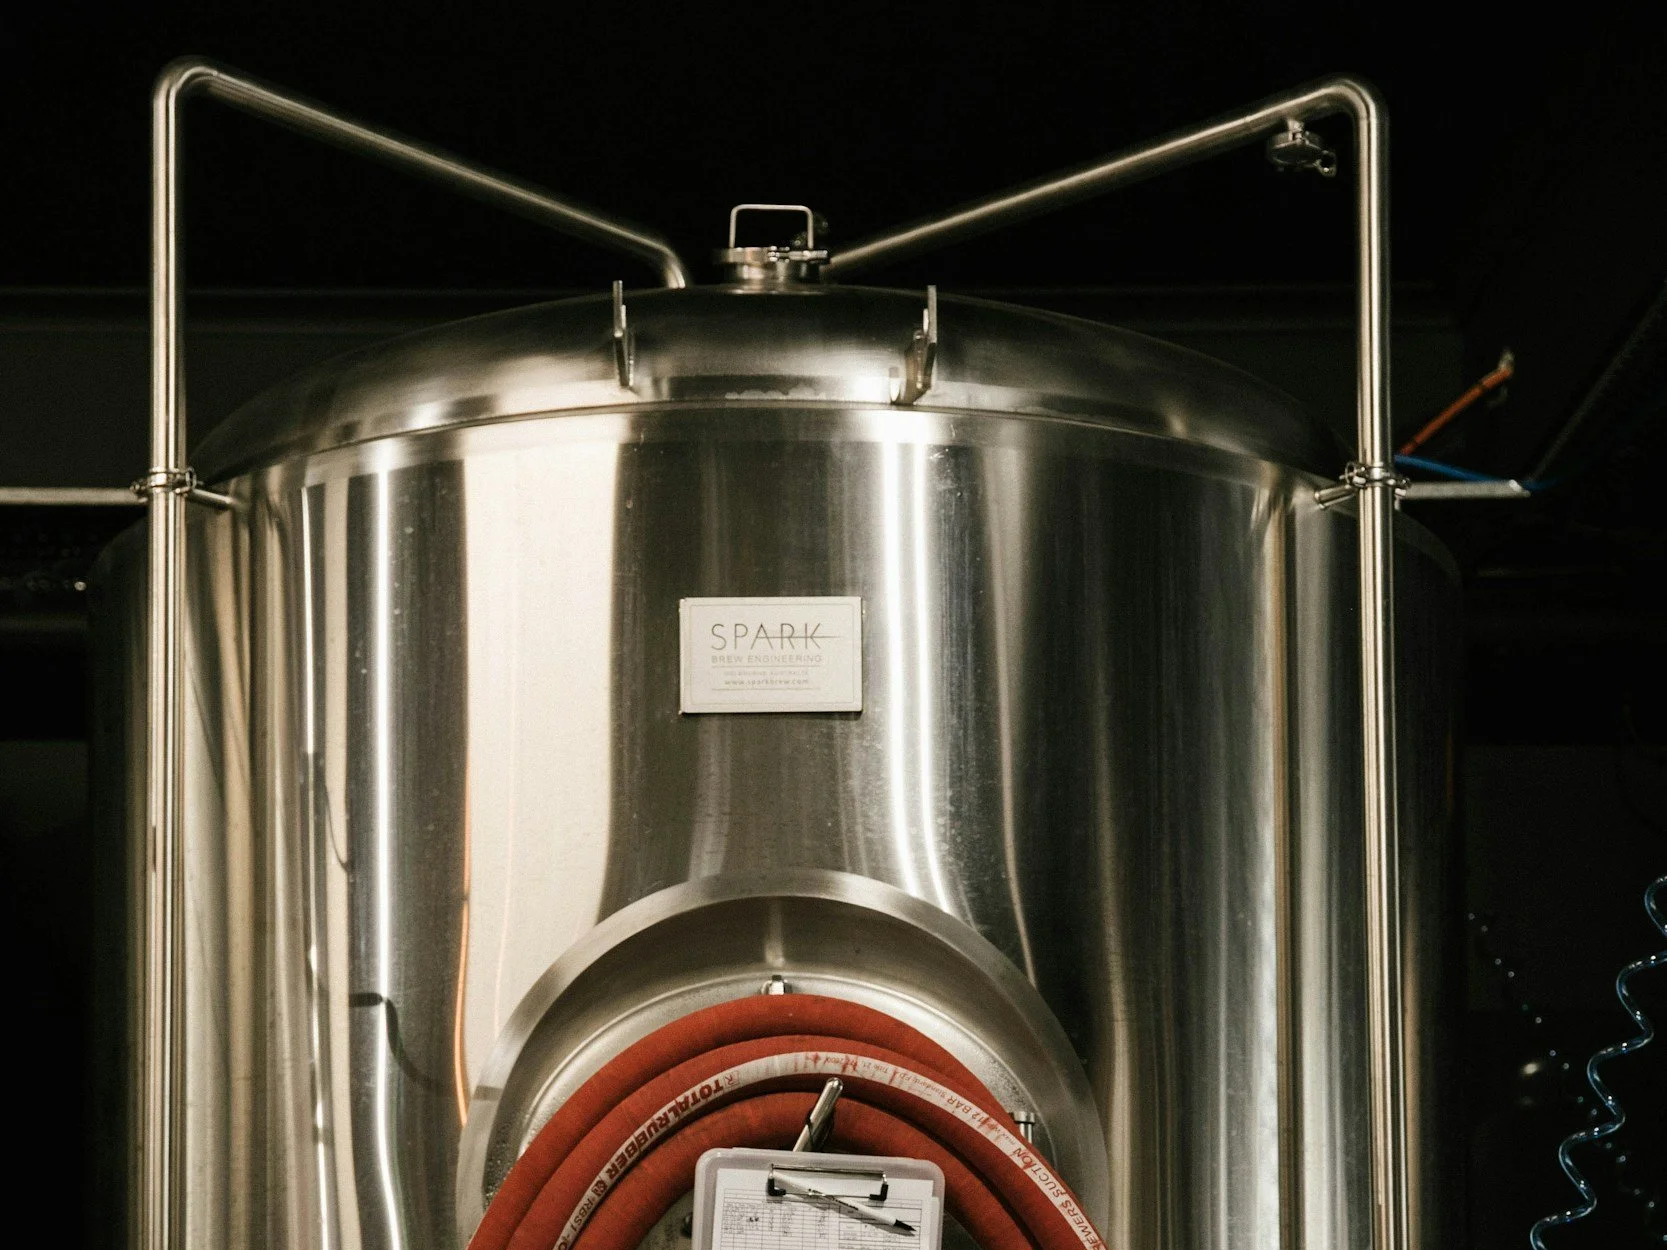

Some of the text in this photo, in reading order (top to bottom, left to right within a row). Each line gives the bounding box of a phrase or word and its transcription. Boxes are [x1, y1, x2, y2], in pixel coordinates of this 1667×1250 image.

[711, 622, 840, 651] SPARK
[711, 654, 822, 664] BREW ENGINEERING
[947, 1093, 971, 1114] BAR
